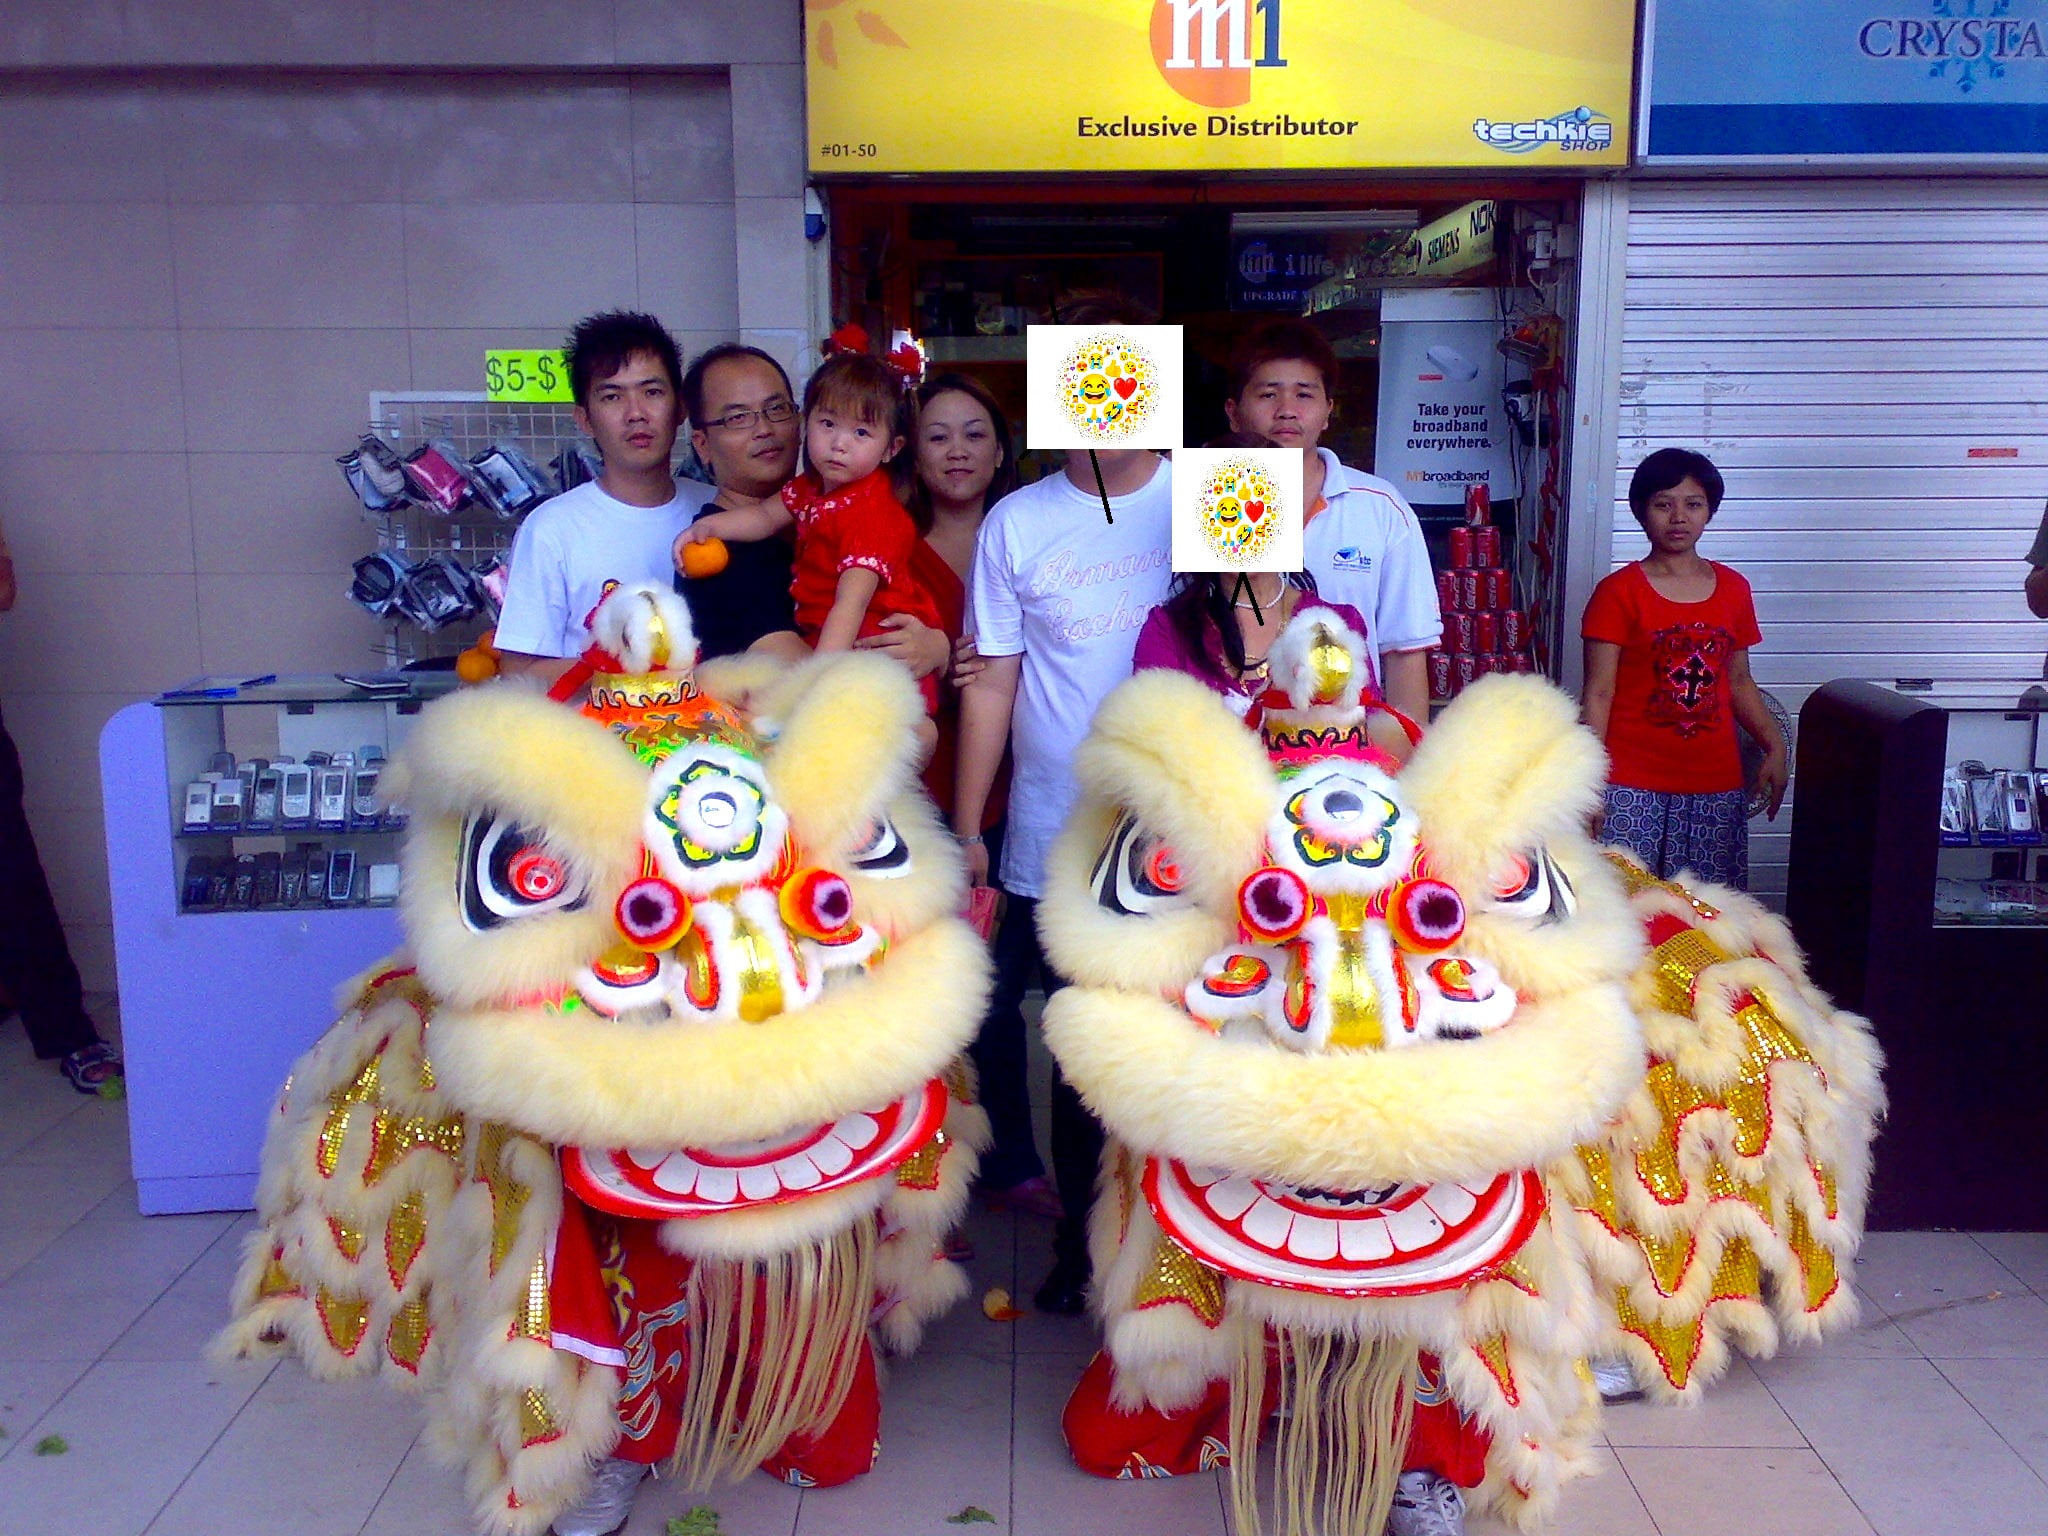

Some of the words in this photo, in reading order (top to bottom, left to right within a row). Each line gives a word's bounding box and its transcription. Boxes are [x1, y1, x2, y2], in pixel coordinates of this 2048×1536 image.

[1860, 19, 2048, 57] CRYSTA
[1078, 116, 1197, 137] Exclusive
[1207, 115, 1358, 136] Distributor
[821, 143, 877, 157] #01-50
[1560, 140, 1611, 152] SHOP
[1428, 228, 1460, 266] SIEMENS
[1418, 403, 1448, 416] Take
[1453, 405, 1486, 418] your
[1413, 419, 1488, 433] broadband
[1406, 436, 1491, 451] everywhere.
